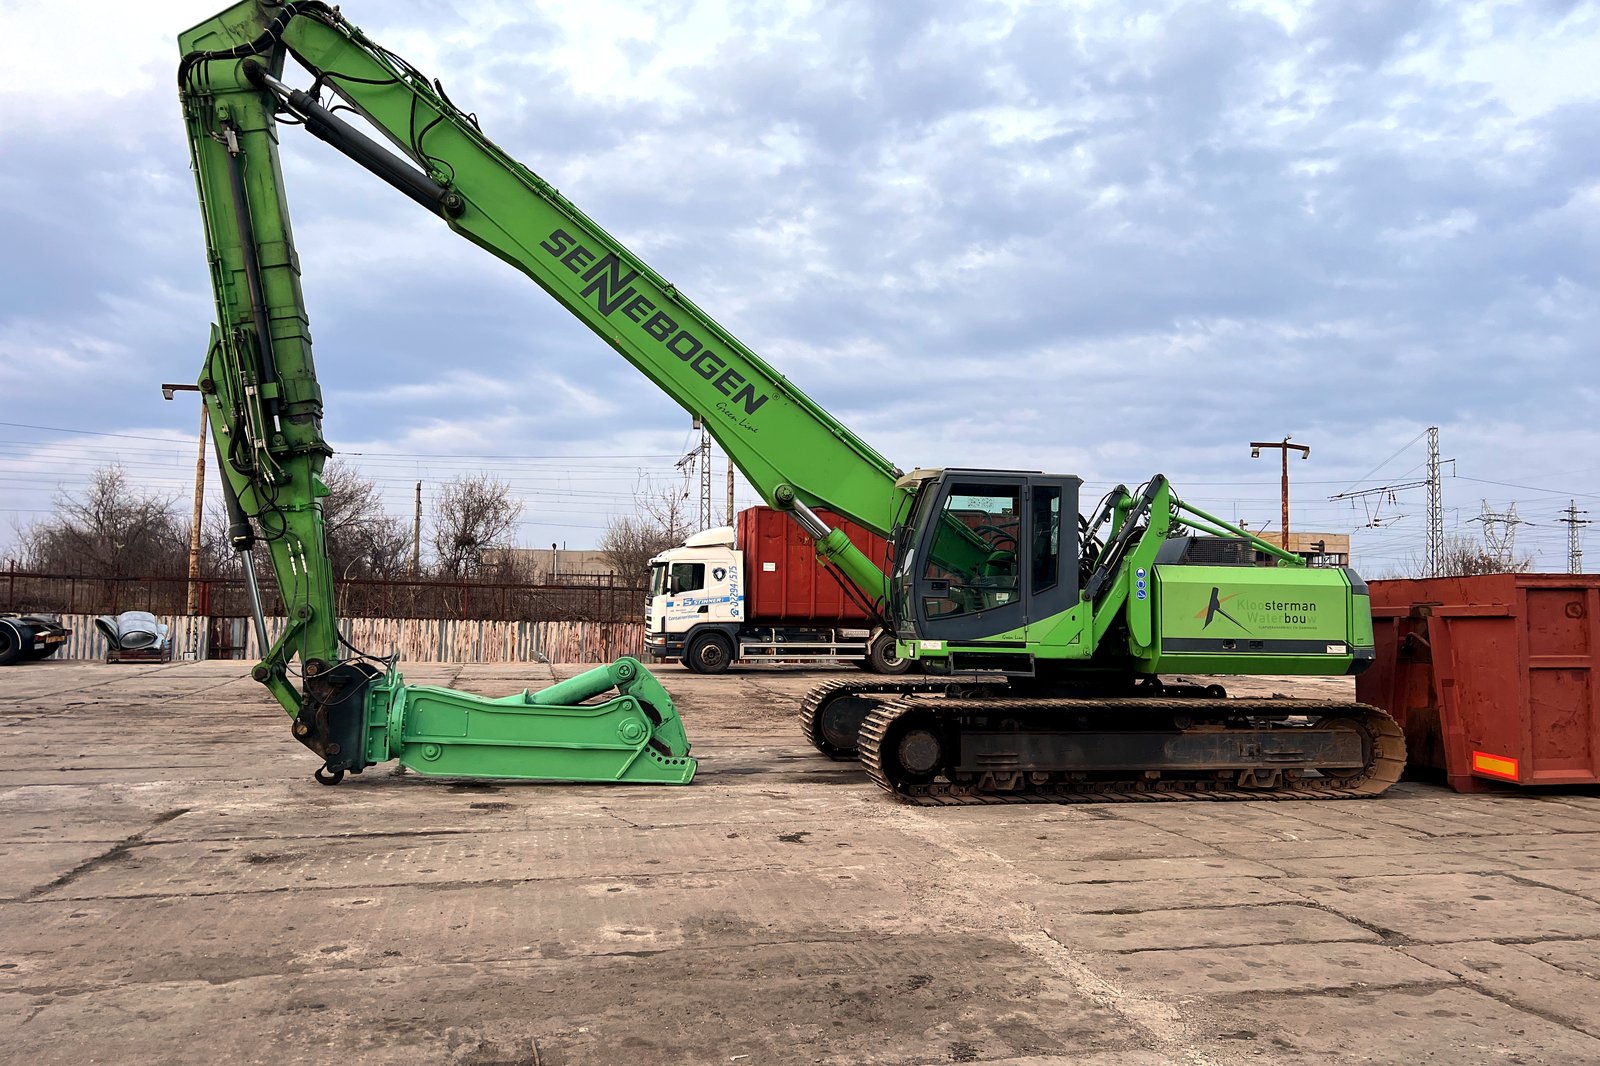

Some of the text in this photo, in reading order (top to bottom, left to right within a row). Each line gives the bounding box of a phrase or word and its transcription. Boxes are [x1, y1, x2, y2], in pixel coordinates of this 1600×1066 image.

[539, 228, 769, 416] SENNEBOGEN
[716, 401, 759, 433] Green Line
[1237, 600, 1316, 611] Kloosterman
[1247, 612, 1316, 623] Waterbouw
